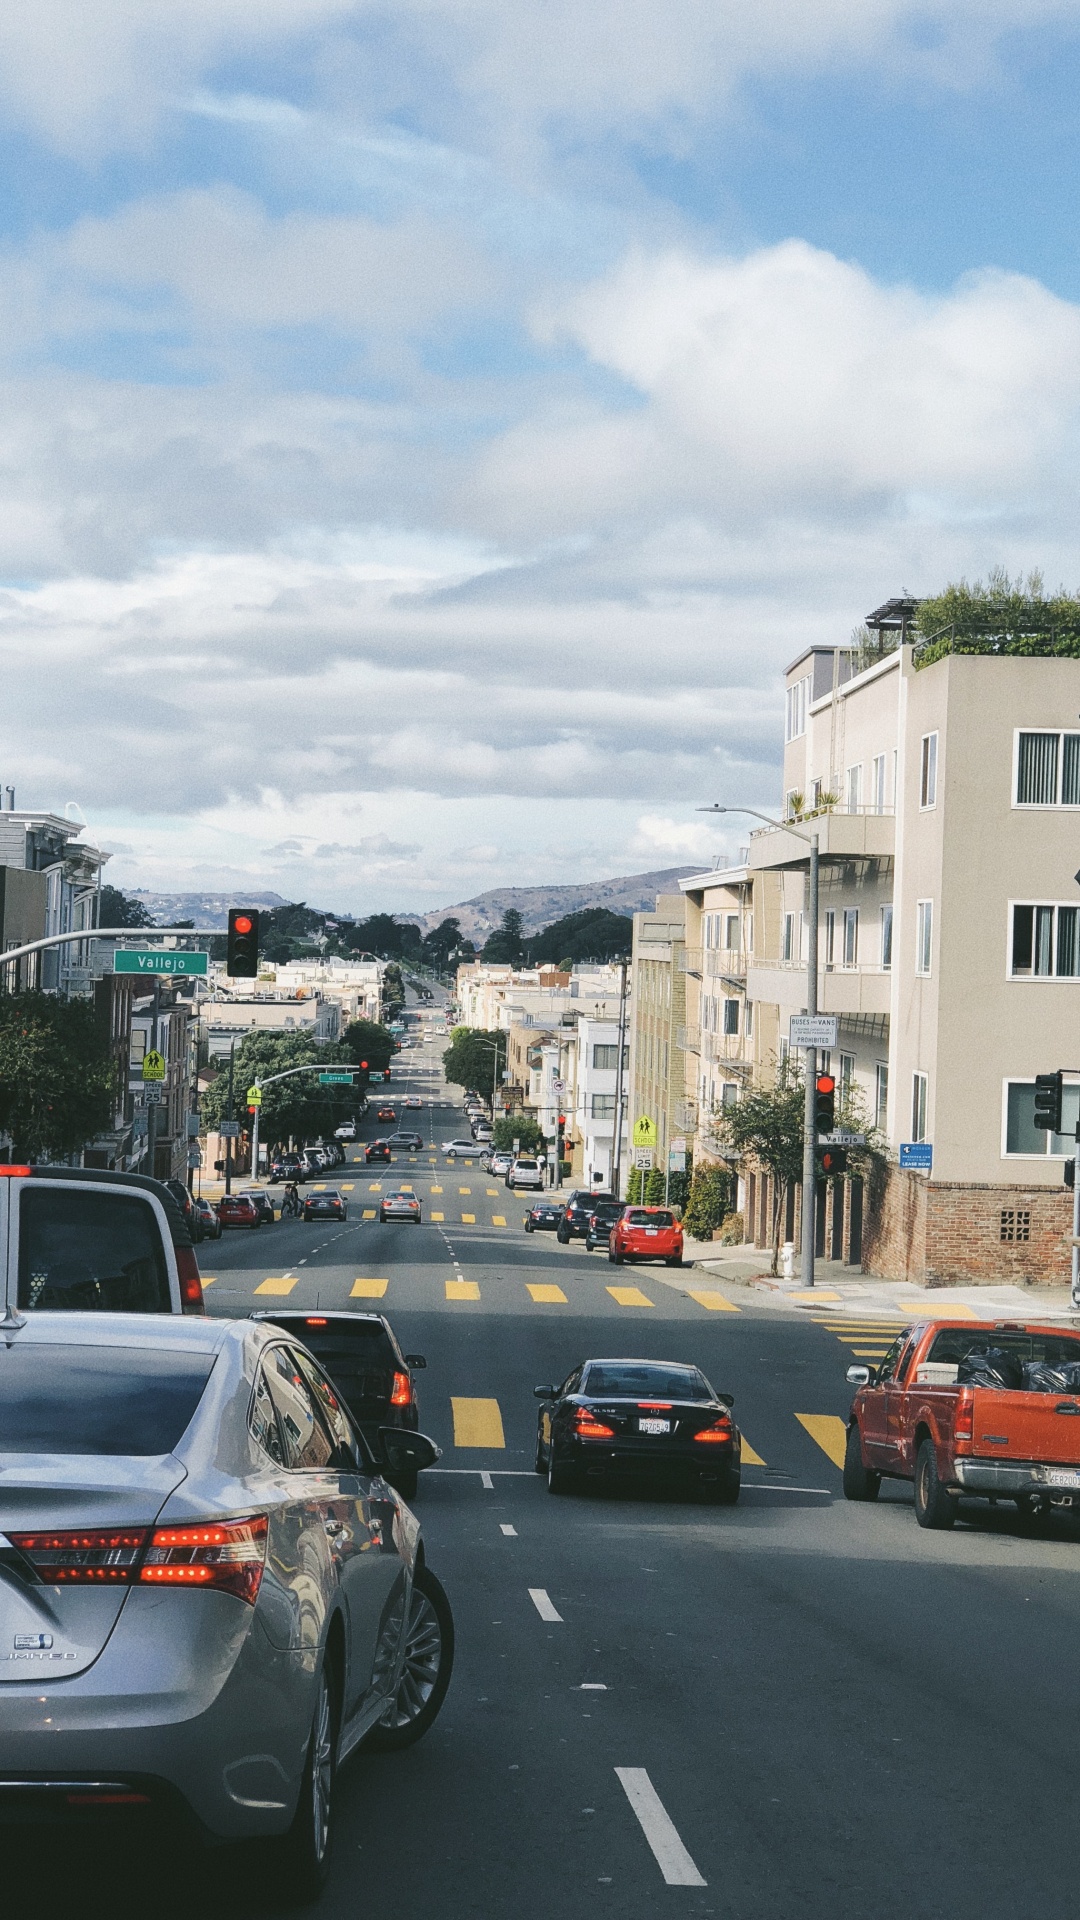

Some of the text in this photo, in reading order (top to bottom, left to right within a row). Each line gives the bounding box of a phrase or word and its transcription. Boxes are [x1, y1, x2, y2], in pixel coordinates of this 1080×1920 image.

[138, 956, 185, 972] Vallejo
[146, 1094, 160, 1102] 25
[826, 1136, 858, 1144] Vallejo
